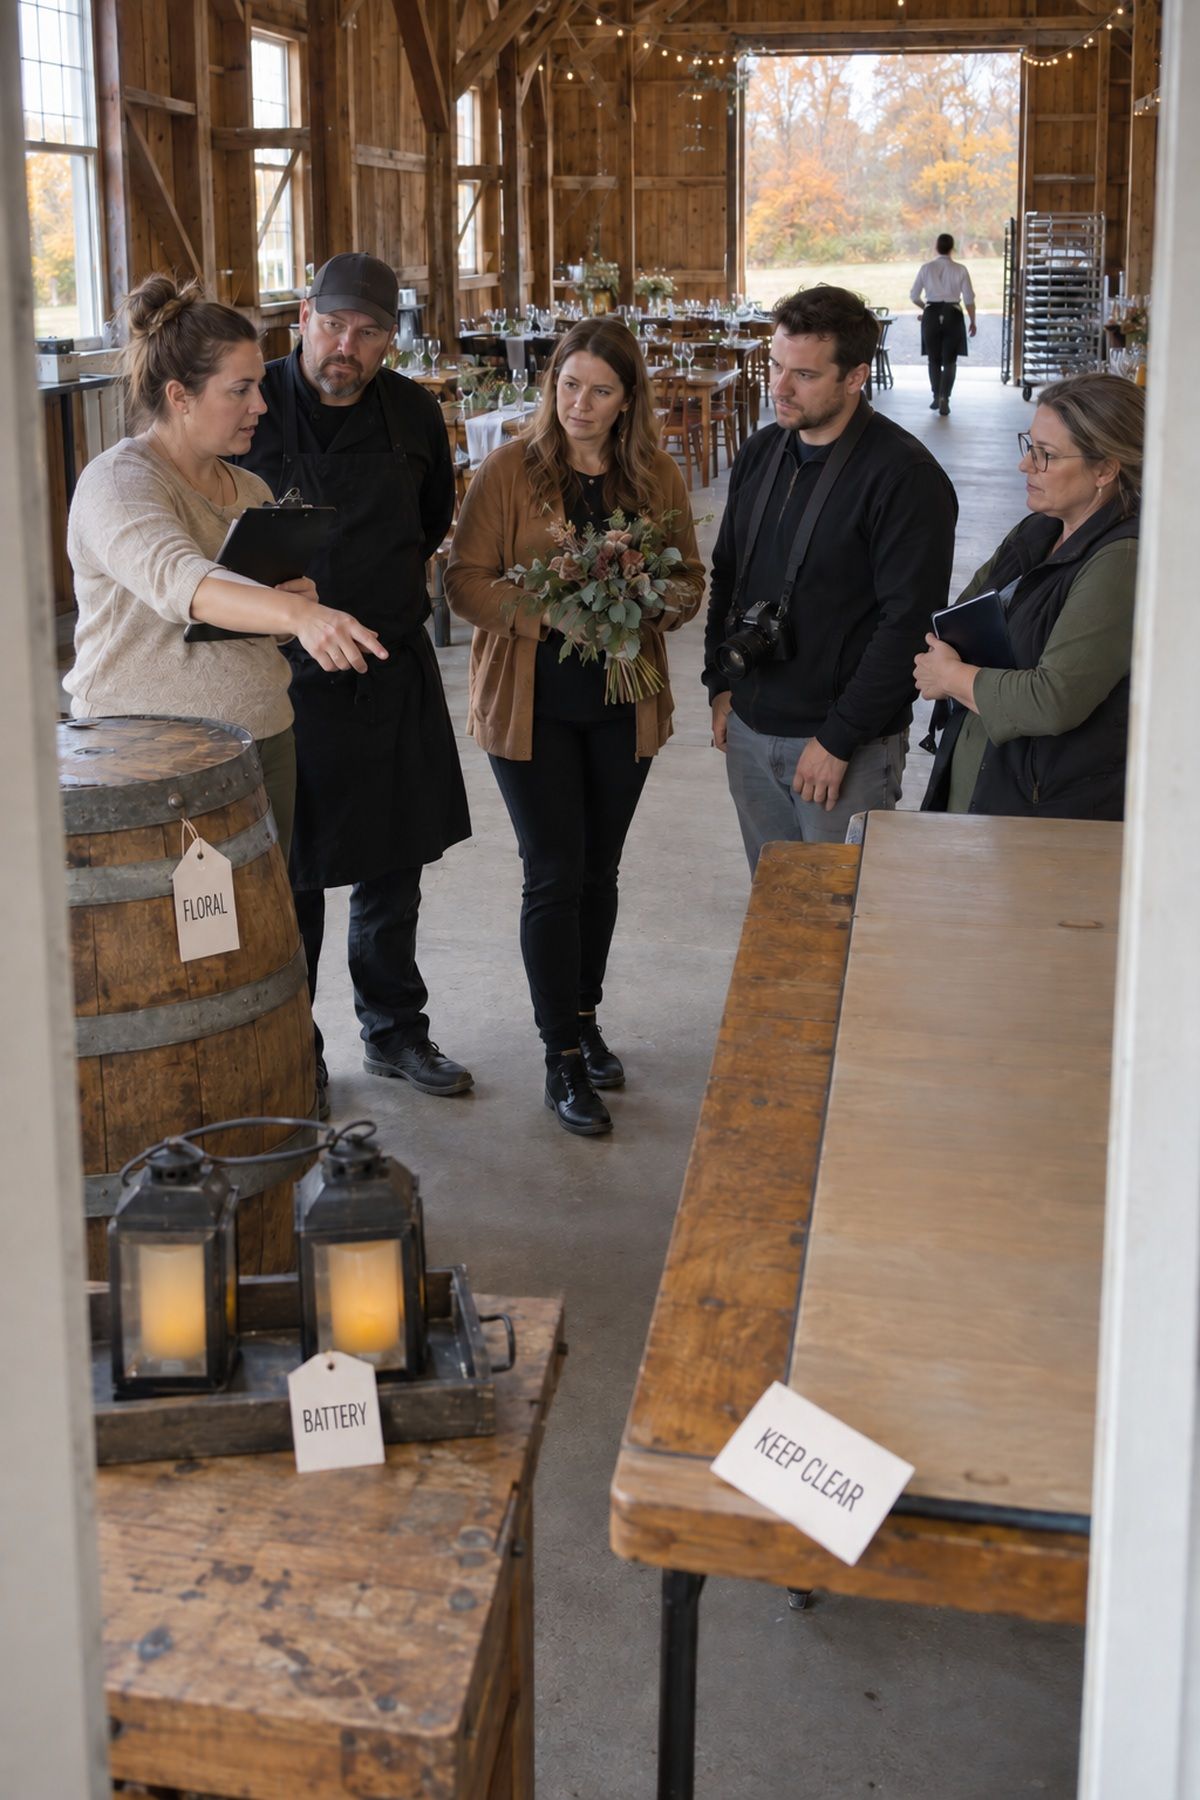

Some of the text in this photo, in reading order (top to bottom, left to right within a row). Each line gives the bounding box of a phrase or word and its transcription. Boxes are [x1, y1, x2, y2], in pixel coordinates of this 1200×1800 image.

[183, 893, 228, 922] FLORAL
[303, 1402, 367, 1433] BATTERY
[754, 1427, 865, 1513] KEEP CLEAR
